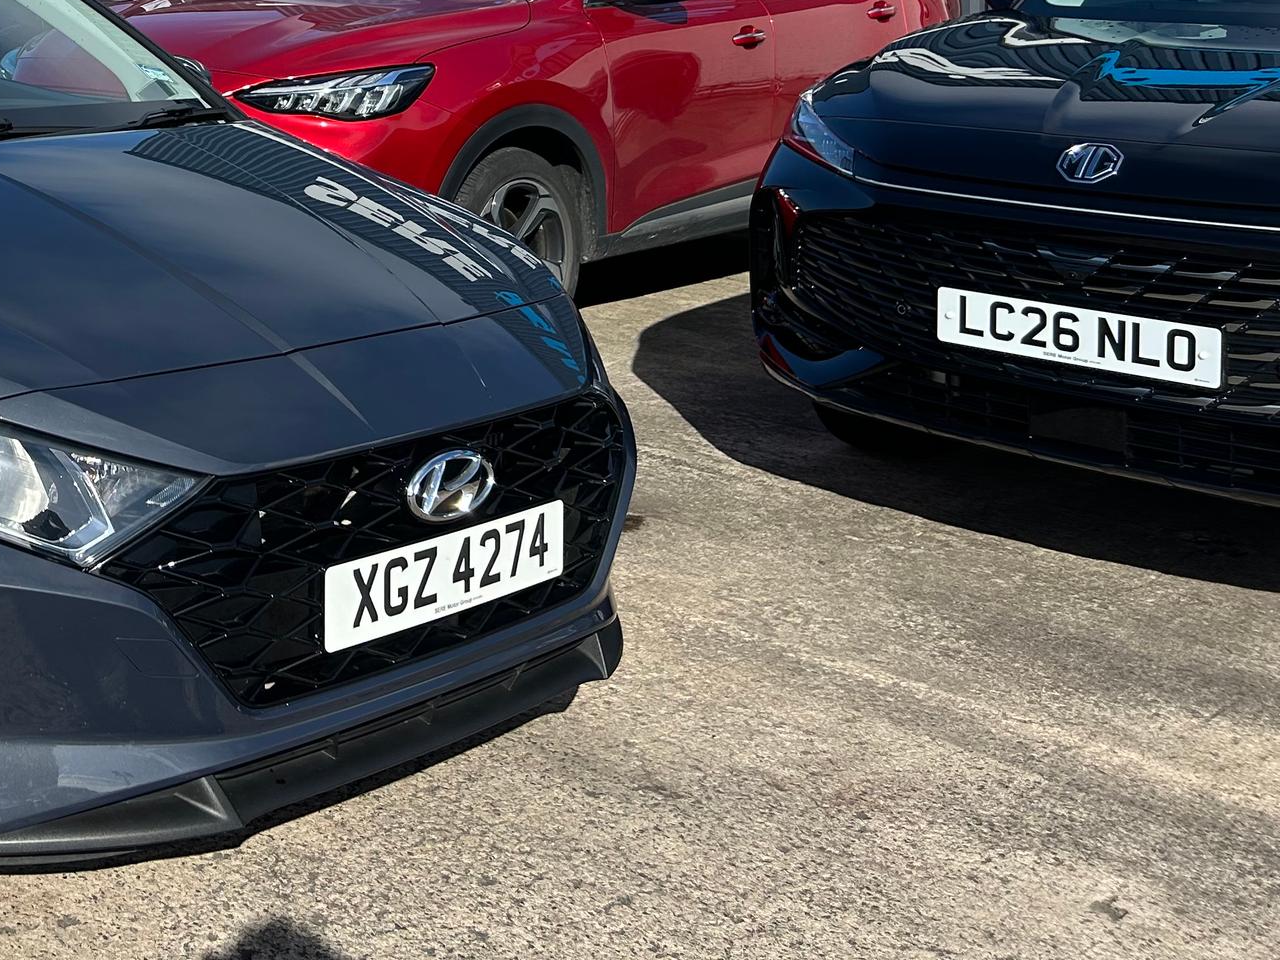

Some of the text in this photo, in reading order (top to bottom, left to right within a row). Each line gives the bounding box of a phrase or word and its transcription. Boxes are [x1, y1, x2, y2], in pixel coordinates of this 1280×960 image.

[1061, 144, 1120, 180] MG
[959, 294, 1196, 372] LC26 NLO
[353, 512, 549, 629] XGZ 4274
